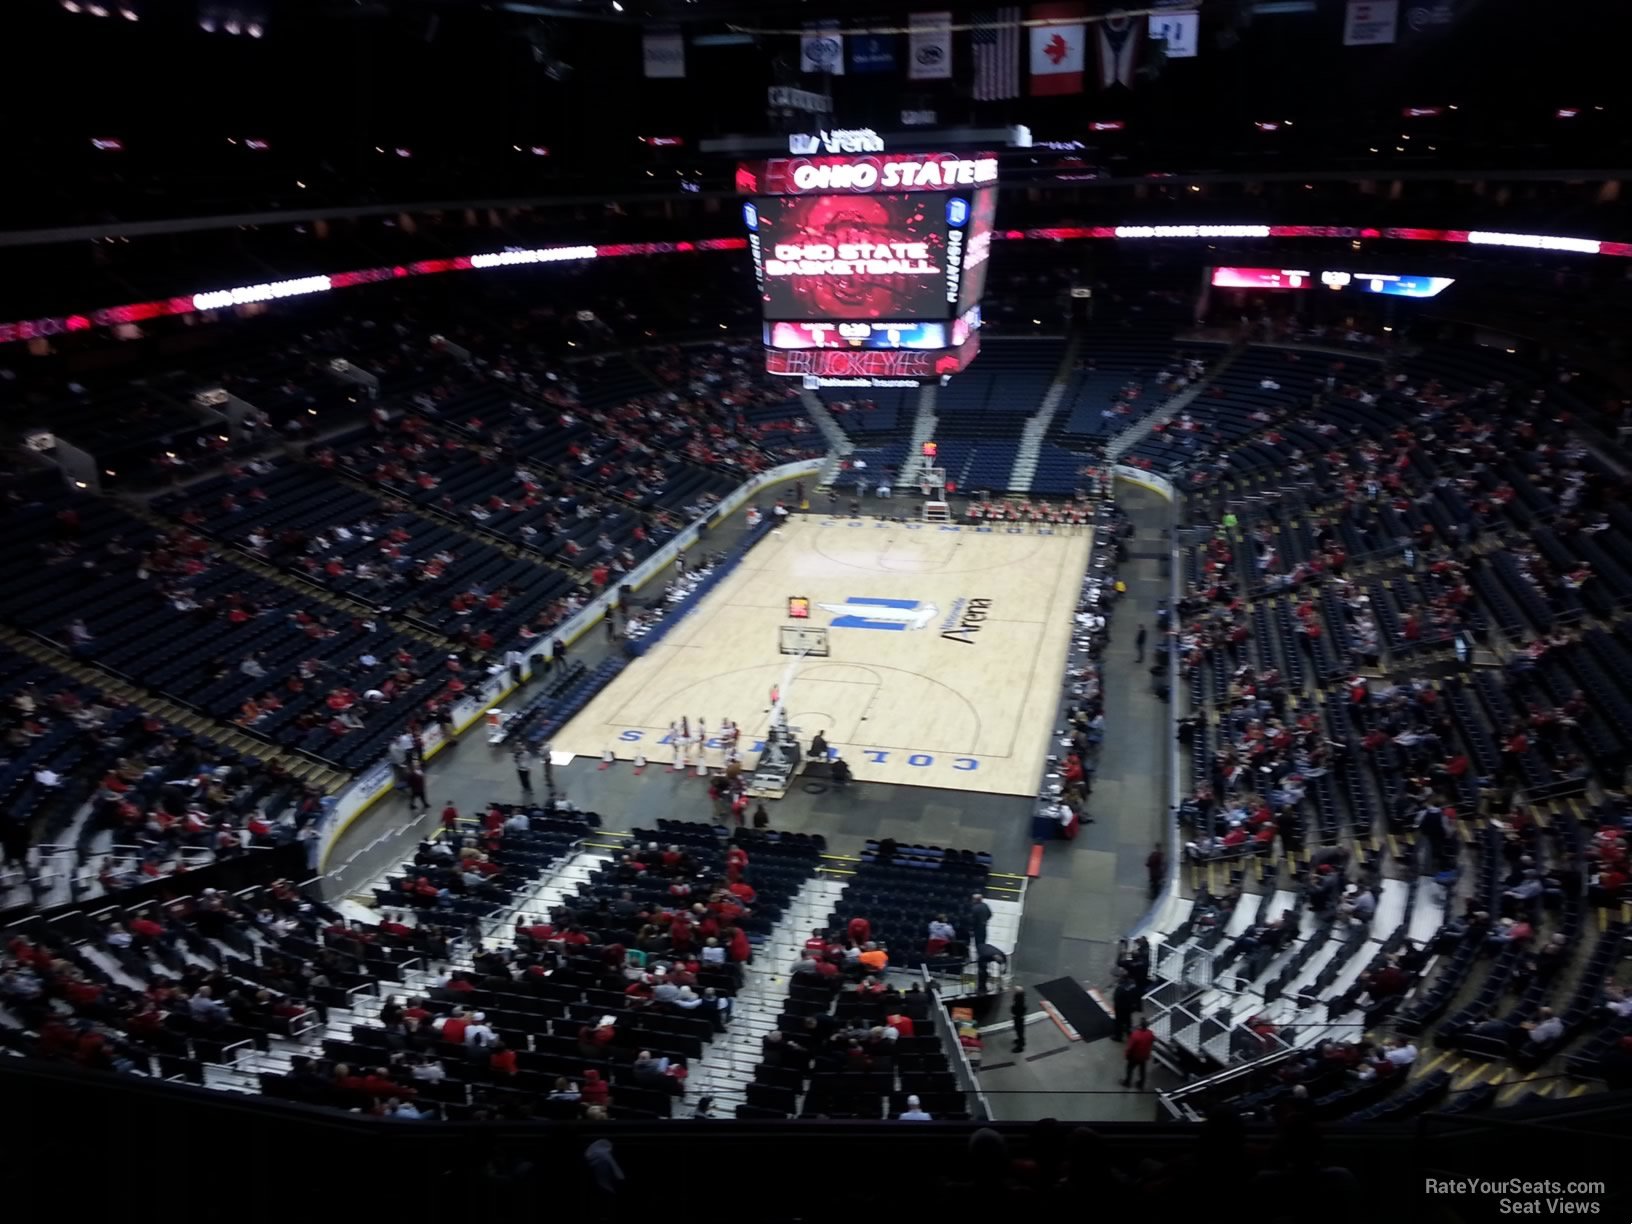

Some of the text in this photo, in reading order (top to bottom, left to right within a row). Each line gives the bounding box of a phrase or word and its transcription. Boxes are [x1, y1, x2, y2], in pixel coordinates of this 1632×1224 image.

[793, 163, 878, 189] OHIO
[774, 243, 929, 261] OHIO STATE
[765, 258, 941, 276] BASKETBALL
[941, 598, 993, 645] Arena
